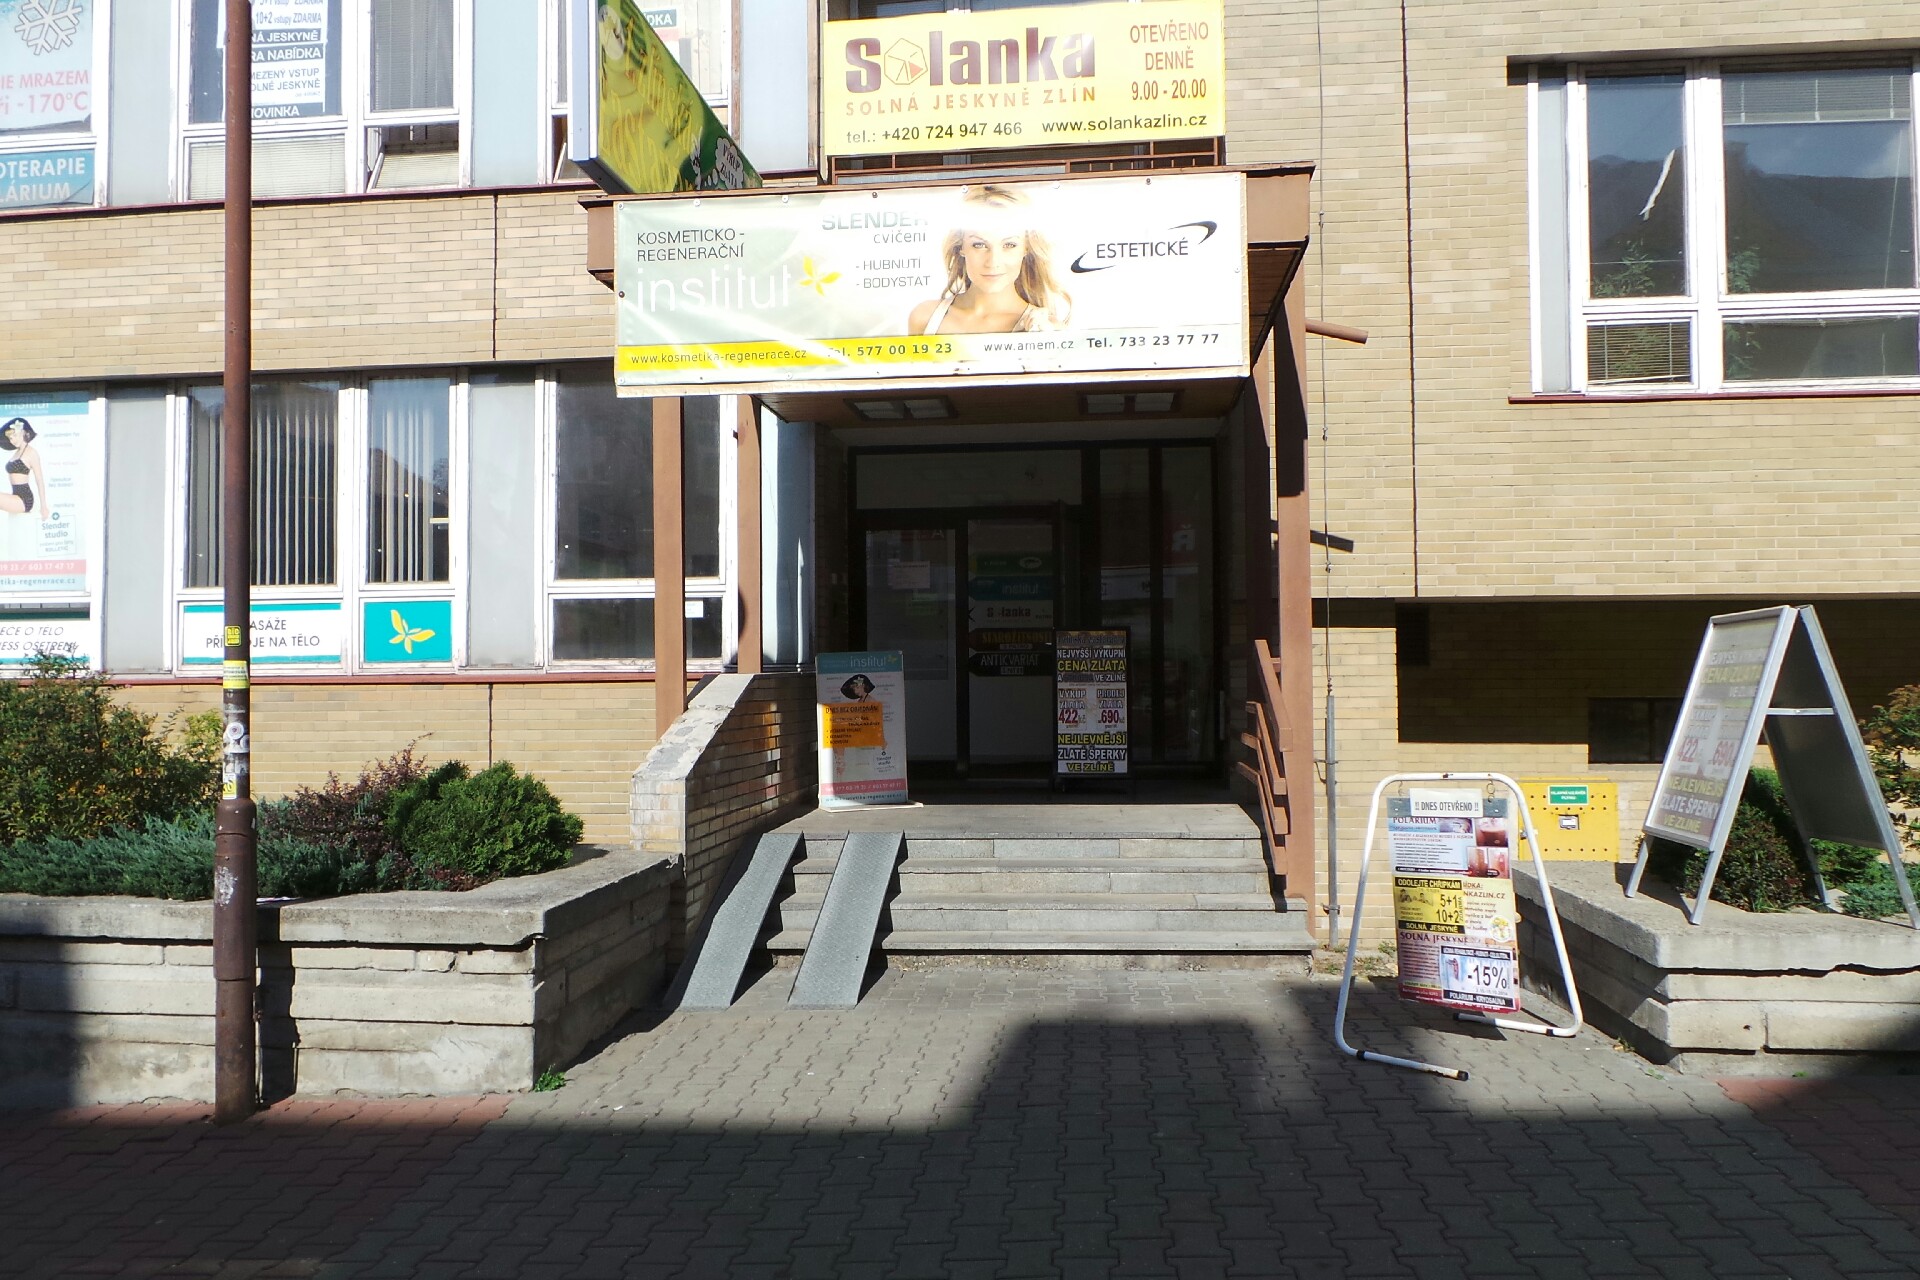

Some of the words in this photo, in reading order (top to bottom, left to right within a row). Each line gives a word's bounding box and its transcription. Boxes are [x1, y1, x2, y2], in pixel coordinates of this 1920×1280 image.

[256, 11, 272, 25] 10+2
[293, 12, 322, 24] ZDARMA
[267, 30, 319, 42] JESKYNĚ
[1129, 19, 1209, 44] OTEVŘENO
[267, 47, 321, 61] NABÍDKA
[1145, 45, 1194, 71] DENNĚ
[20, 70, 89, 88] MRAZEM
[288, 68, 320, 78] VSTUP
[1131, 80, 1159, 100] 9.00
[1171, 78, 1207, 99] 20.00
[846, 92, 919, 116] SOLNÁ
[932, 87, 1030, 110] JESKYNĚ
[1043, 83, 1096, 104] ZLÍN
[882, 126, 920, 141] +420
[925, 125, 954, 139] 724
[959, 123, 988, 137] 947
[993, 121, 1023, 135] 466
[1042, 114, 1208, 133] www.solankazlin.cz
[637, 228, 736, 246] KOSMETICKO
[637, 243, 745, 262] REGENERAČNÍ
[1096, 237, 1189, 260] ESTETICKÉ
[636, 264, 792, 313] institut
[863, 275, 931, 289] BODYSTAT
[1086, 336, 1112, 349] Tel.
[1119, 336, 1146, 347] 733
[1153, 335, 1170, 346] 23
[1177, 334, 1195, 345] 77
[1201, 333, 1219, 344] 77
[631, 349, 807, 365] www.kosmetika-regenerace.cz
[857, 346, 883, 357] 577
[889, 345, 906, 355] 00
[912, 344, 929, 354] 19
[935, 343, 952, 353] 23
[269, 637, 287, 648] NA
[292, 633, 320, 647] TĚLO
[1057, 660, 1088, 671] CENA
[1090, 660, 1126, 671] ZLATA
[1059, 709, 1079, 725] 422
[1101, 709, 1120, 724] 690
[1058, 731, 1126, 745] NEJLEVNĚJŠÍ
[1089, 746, 1126, 760] ŠPERKY
[1067, 763, 1081, 772] VE
[1421, 801, 1438, 811] DNES
[1440, 894, 1458, 908] 5+1
[1436, 909, 1460, 924] 10+2
[1467, 964, 1507, 990] -15%
